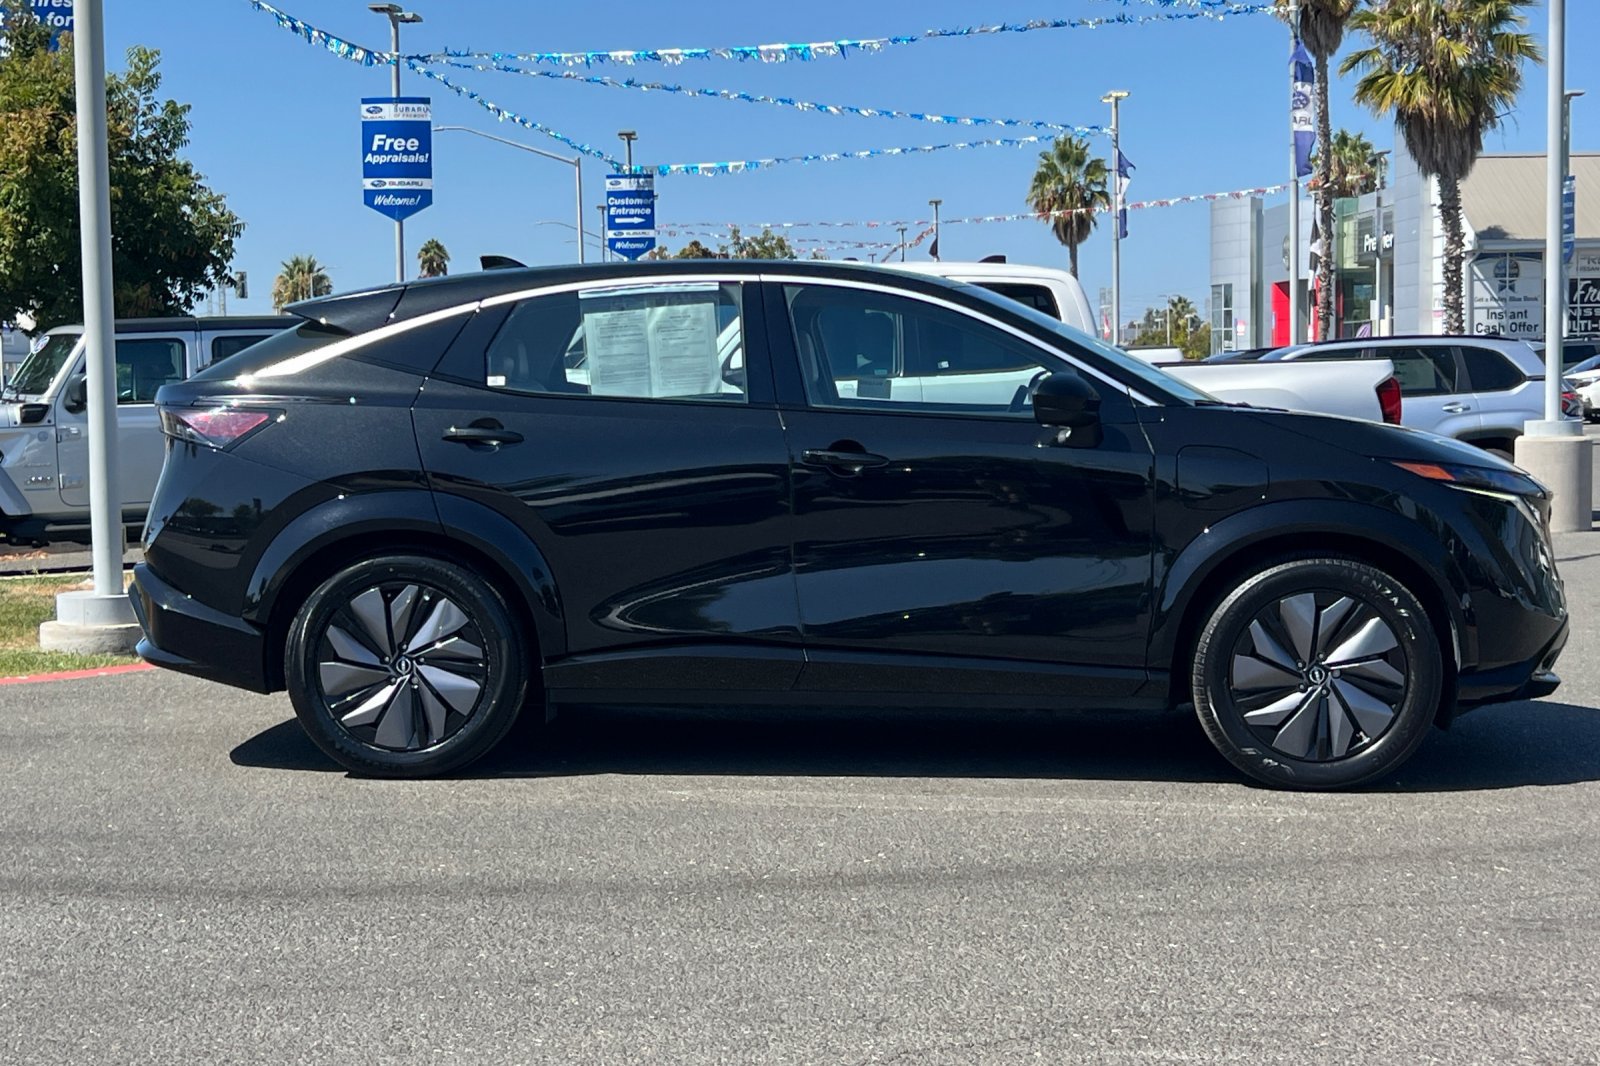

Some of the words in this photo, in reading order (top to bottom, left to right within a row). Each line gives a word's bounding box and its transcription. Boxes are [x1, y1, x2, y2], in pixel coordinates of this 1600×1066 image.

[46, 11, 74, 27] for
[372, 134, 419, 151] Free
[364, 153, 429, 164] Appraisals!
[374, 194, 421, 206] Welcome!
[608, 197, 653, 205] Customer
[610, 207, 651, 215] Entrance
[615, 241, 648, 249] Welcome!
[1364, 231, 1394, 252] Preier
[1475, 322, 1506, 334] Cash
[1509, 322, 1540, 333] Offer
